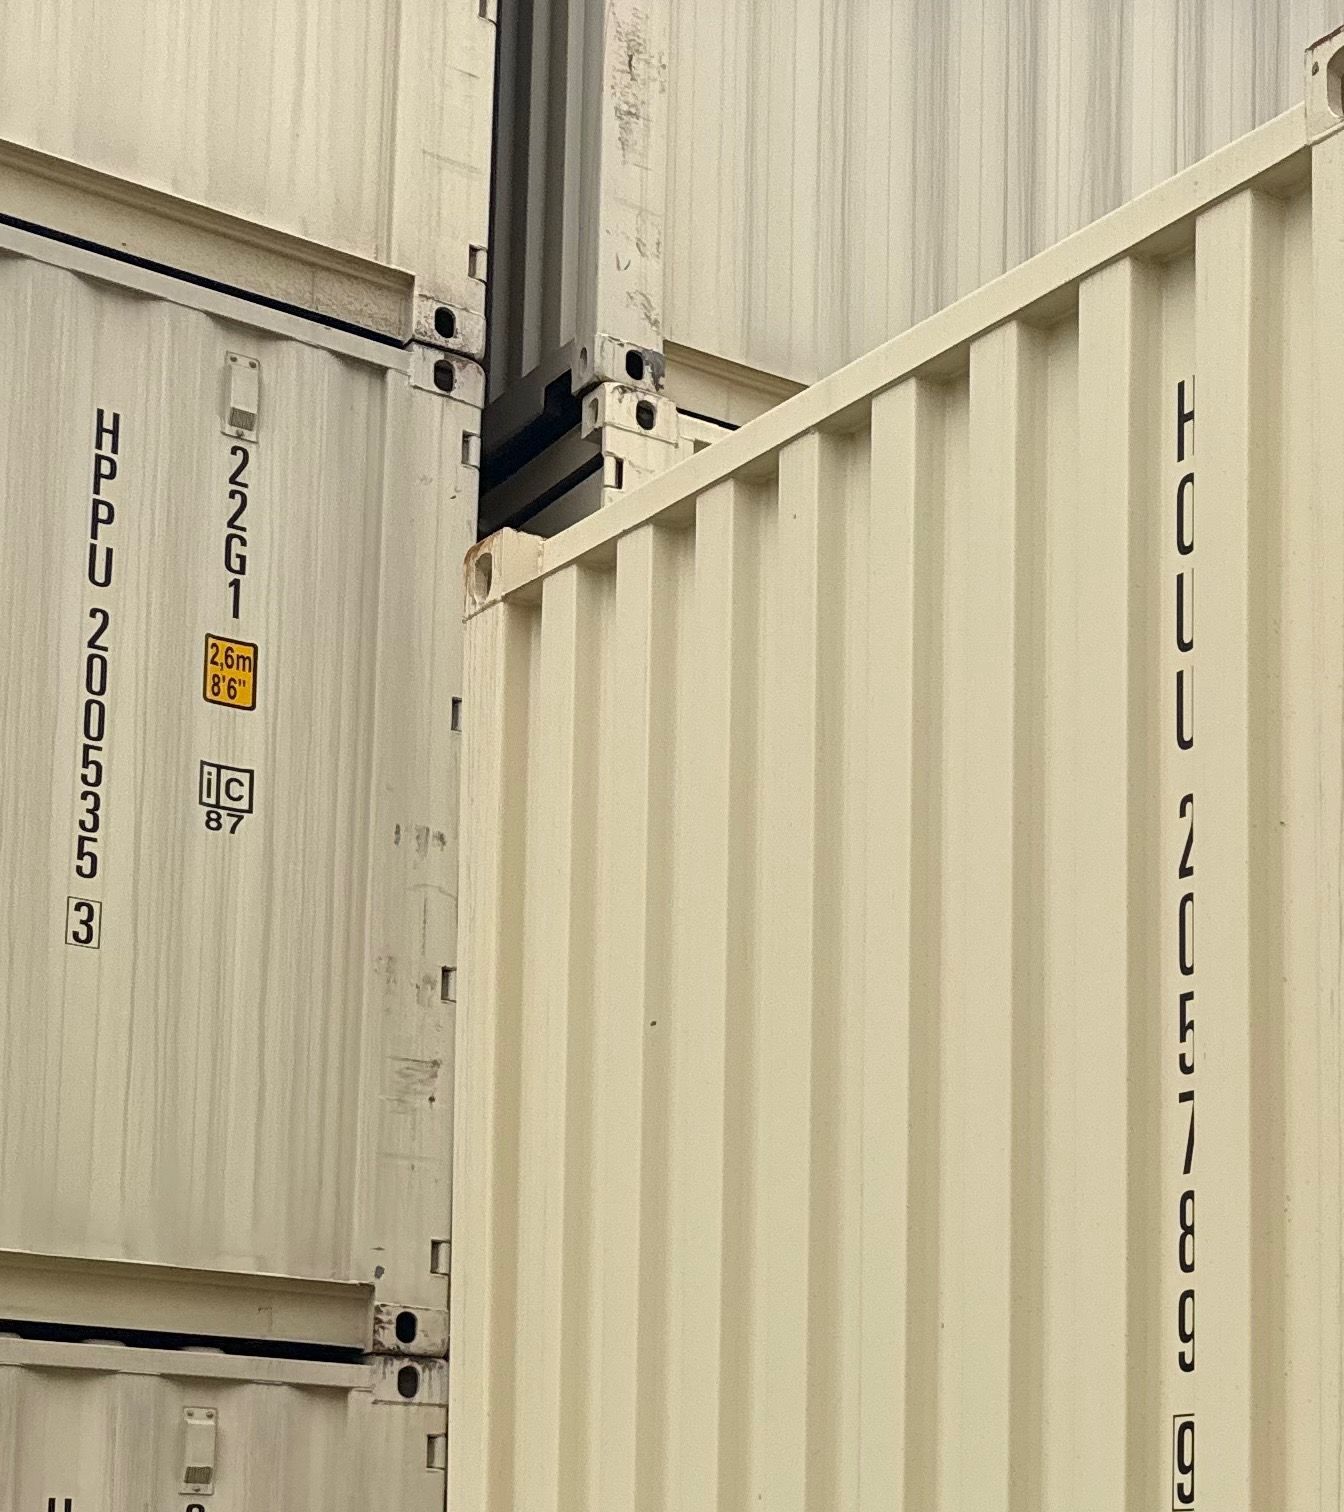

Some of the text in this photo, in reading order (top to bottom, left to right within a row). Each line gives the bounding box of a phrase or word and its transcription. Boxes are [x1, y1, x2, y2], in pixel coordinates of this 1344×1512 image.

[225, 446, 249, 619] 22G1
[73, 409, 119, 946] HPPU 200535 3
[209, 642, 253, 674] 2,6m
[205, 809, 246, 834] 87
